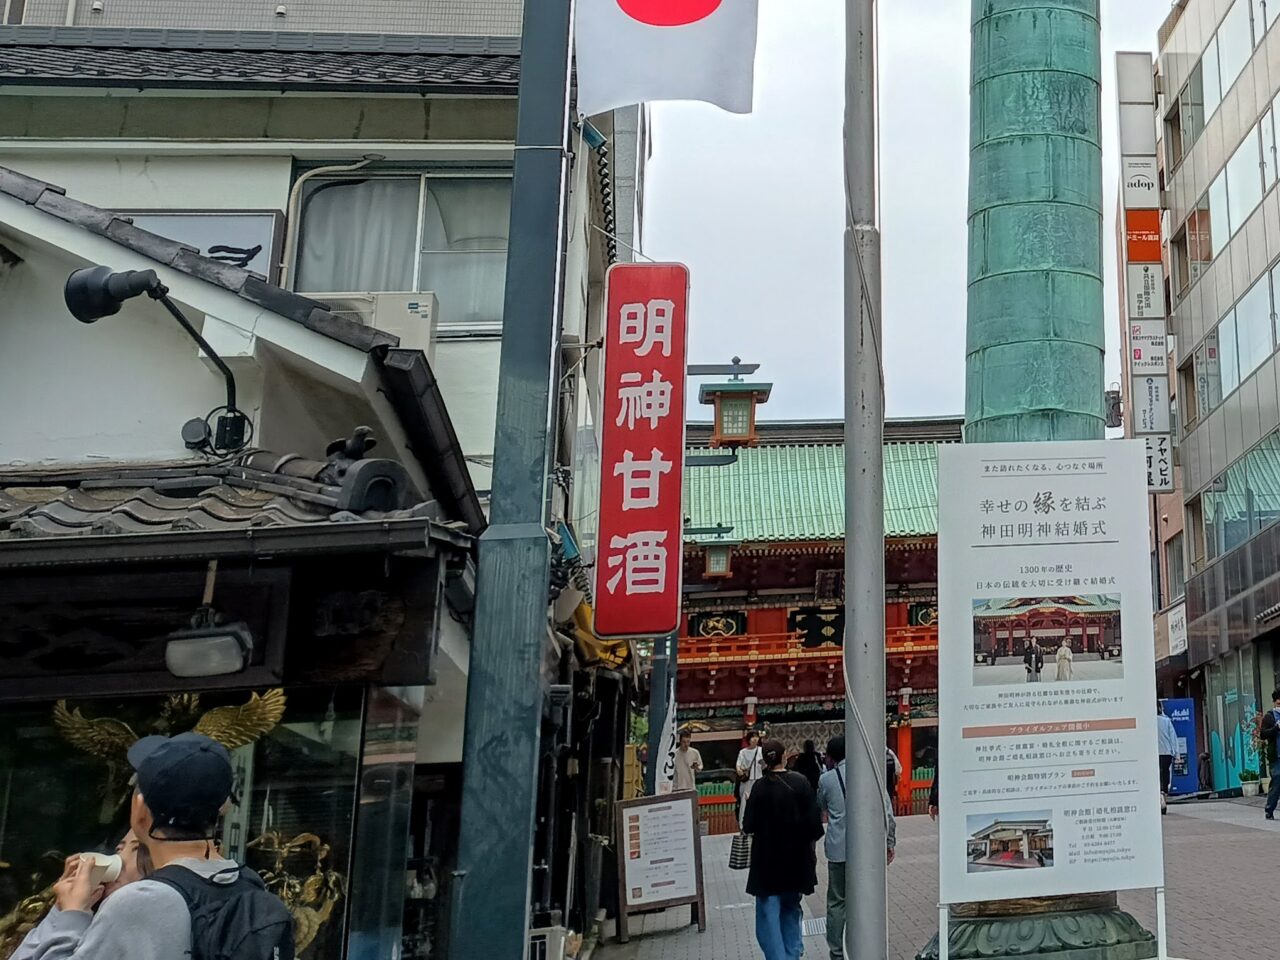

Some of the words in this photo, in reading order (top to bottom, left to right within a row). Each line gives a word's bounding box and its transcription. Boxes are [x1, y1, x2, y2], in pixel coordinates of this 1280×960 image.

[1127, 179, 1154, 191] adop
[606, 298, 676, 596] 明神甘酒
[1157, 437, 1170, 487] アヤベビル
[979, 491, 1107, 515] 幸せの縁を結ぶ
[981, 520, 1107, 539] 神田明神結婚式
[976, 576, 1116, 590] 日本の伝統を大切に受け継ぐ結婚式
